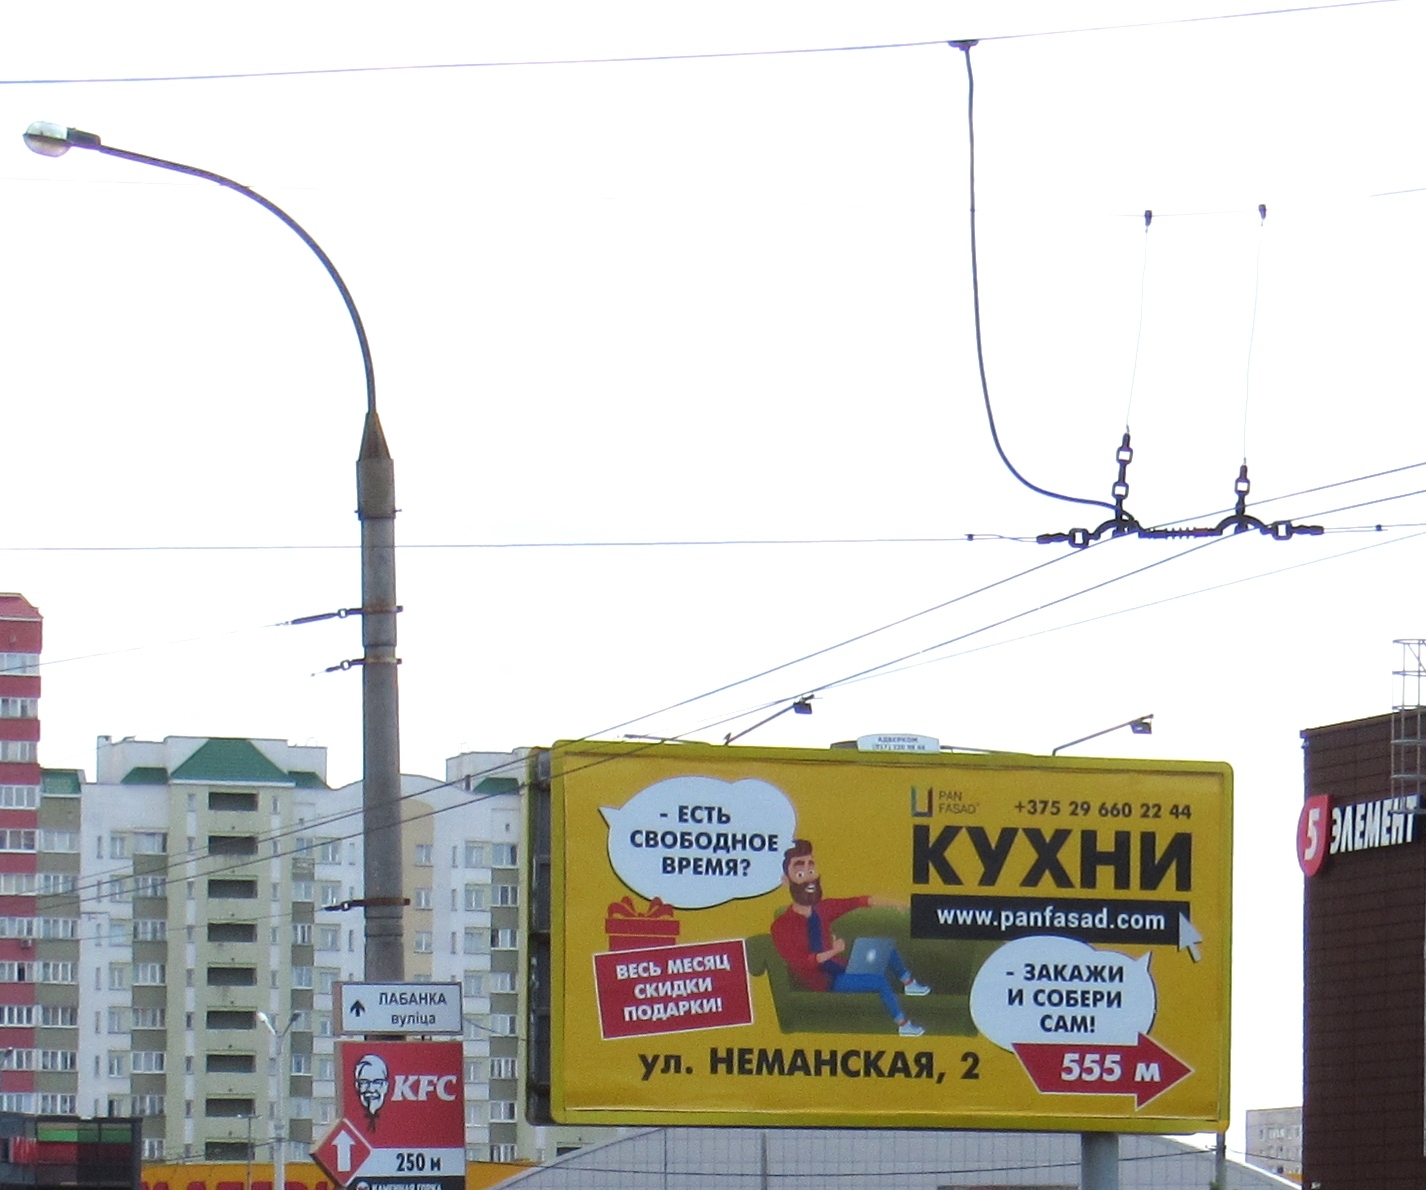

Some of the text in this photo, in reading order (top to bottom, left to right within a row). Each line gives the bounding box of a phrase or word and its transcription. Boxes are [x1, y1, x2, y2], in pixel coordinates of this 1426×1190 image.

[939, 791, 962, 801] PAN
[678, 805, 731, 824] ЕСТЬ
[1015, 801, 1192, 819] +375 29 660 22 44
[1304, 794, 1419, 860] 5 ЭЛЕМЕНТ
[630, 830, 778, 853] СВОБОДНОЕ
[662, 857, 751, 876] ВРЕМЯ?
[912, 824, 1192, 892] КУХНИ
[937, 906, 1166, 930] www.panfasad.com
[616, 954, 731, 980] ВЕСЬ МЕСЯЦ
[1024, 964, 1124, 983] ЗАКАЖИ
[634, 977, 713, 999] СКИДКИ
[379, 993, 447, 1005] ЛАБАНКА
[1008, 989, 1122, 1008] И СОБЕРИ
[391, 1012, 436, 1027] вуліца
[624, 998, 722, 1021] ПОДАРКИ!
[1040, 1015, 1095, 1033] САМ!
[639, 1048, 980, 1084] ул. НЕМАНСКАЯ, 2
[1061, 1053, 1161, 1082] 555 м
[391, 1075, 457, 1101] KFC
[396, 1153, 425, 1171] 250
